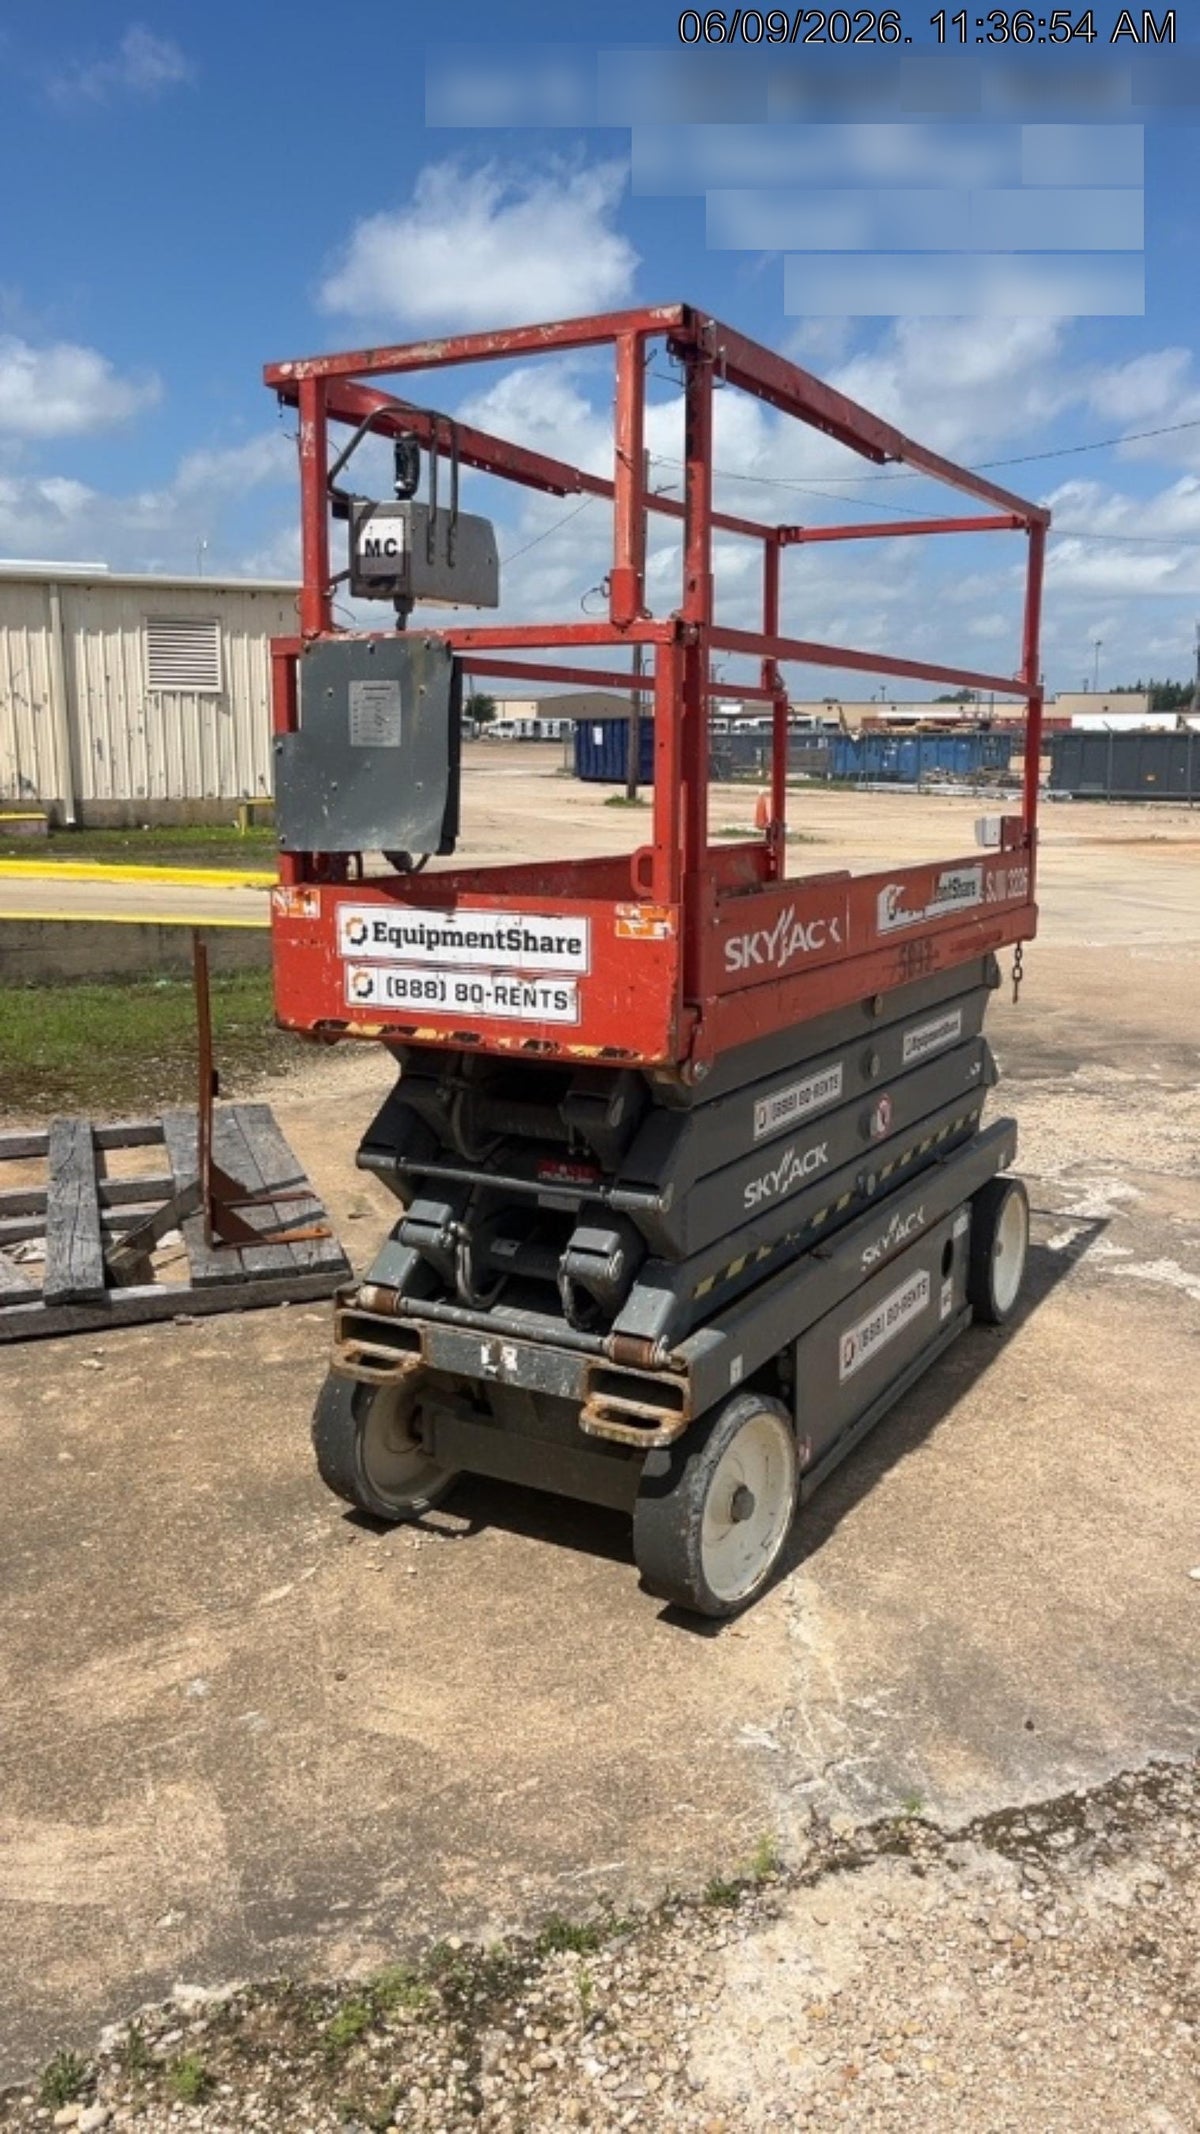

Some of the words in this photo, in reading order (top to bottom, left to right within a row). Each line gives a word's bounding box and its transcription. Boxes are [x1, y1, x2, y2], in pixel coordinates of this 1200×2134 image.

[364, 538, 397, 558] MC
[372, 921, 582, 955] EquipmentShare
[386, 975, 447, 1002] (888)
[455, 982, 568, 1011] 80-RENTS
[744, 1142, 829, 1208] SKYJACK
